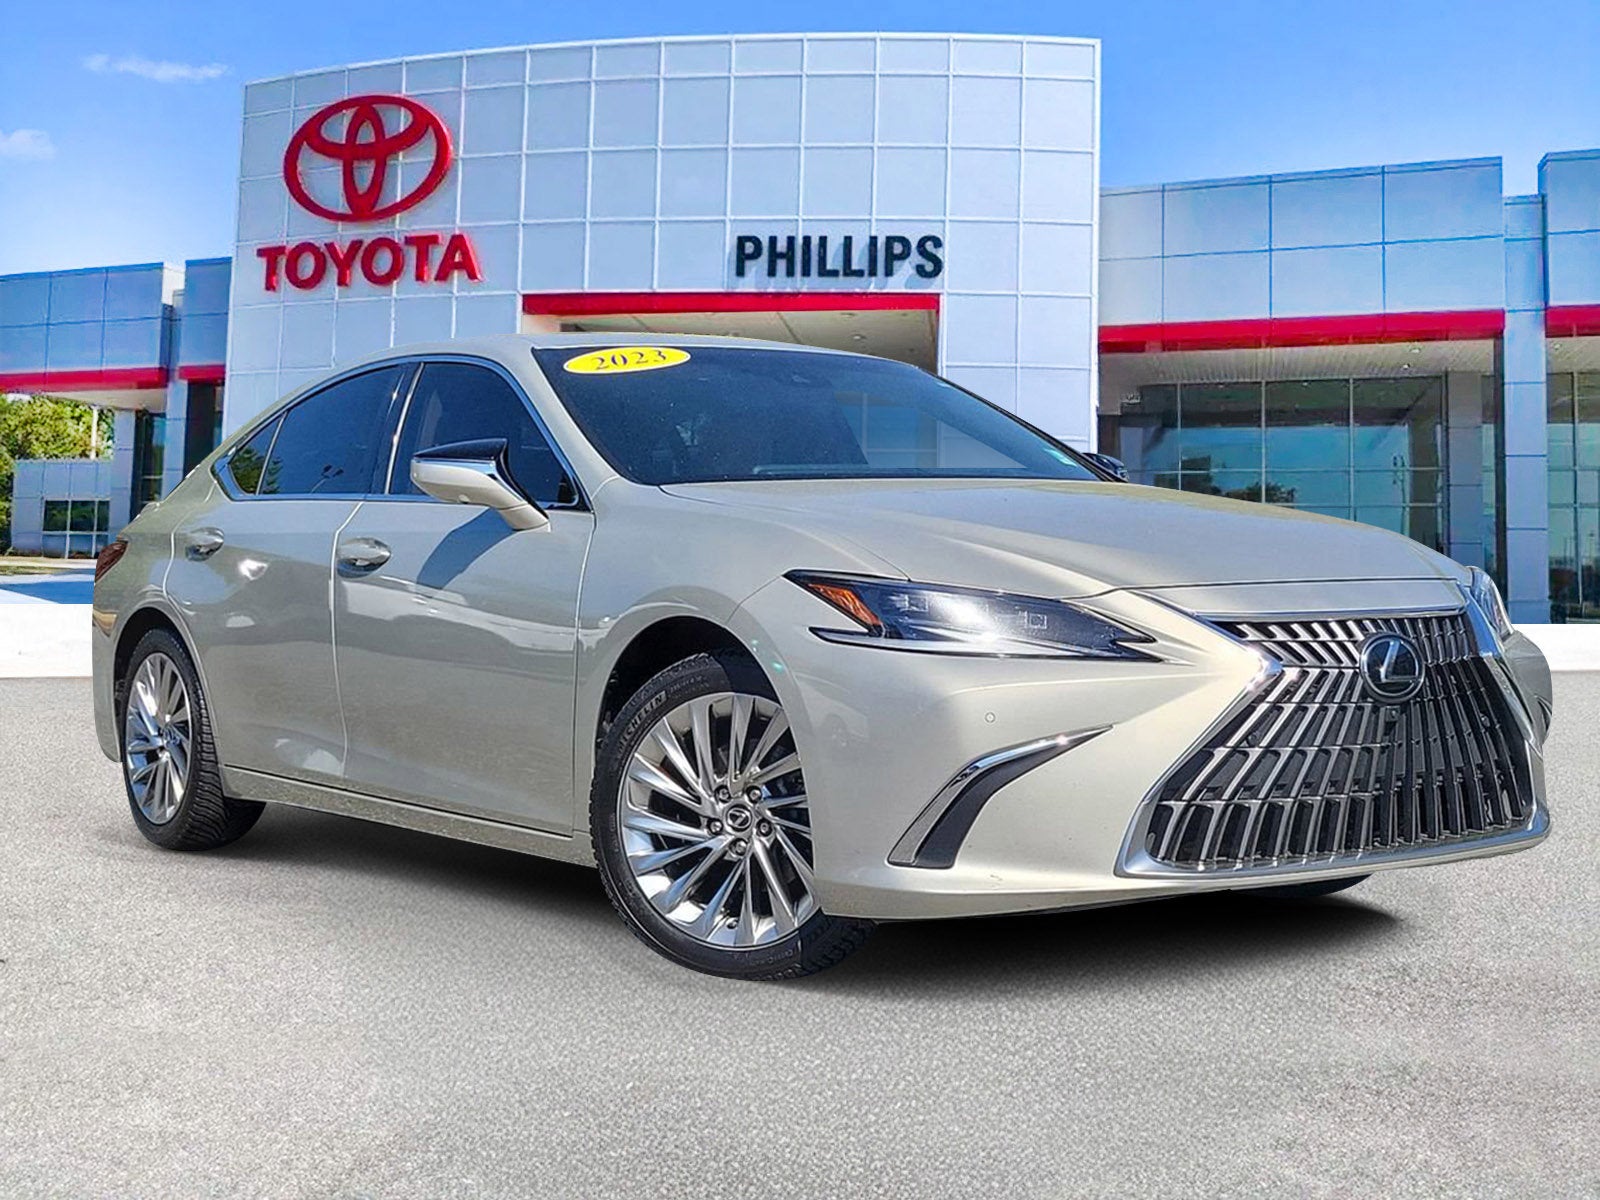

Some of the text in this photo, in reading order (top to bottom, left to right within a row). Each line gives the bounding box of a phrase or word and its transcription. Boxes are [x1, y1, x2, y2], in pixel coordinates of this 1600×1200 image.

[256, 233, 482, 291] TOYOTA
[736, 235, 944, 278] PHILLIPS
[591, 349, 668, 371] 2023
